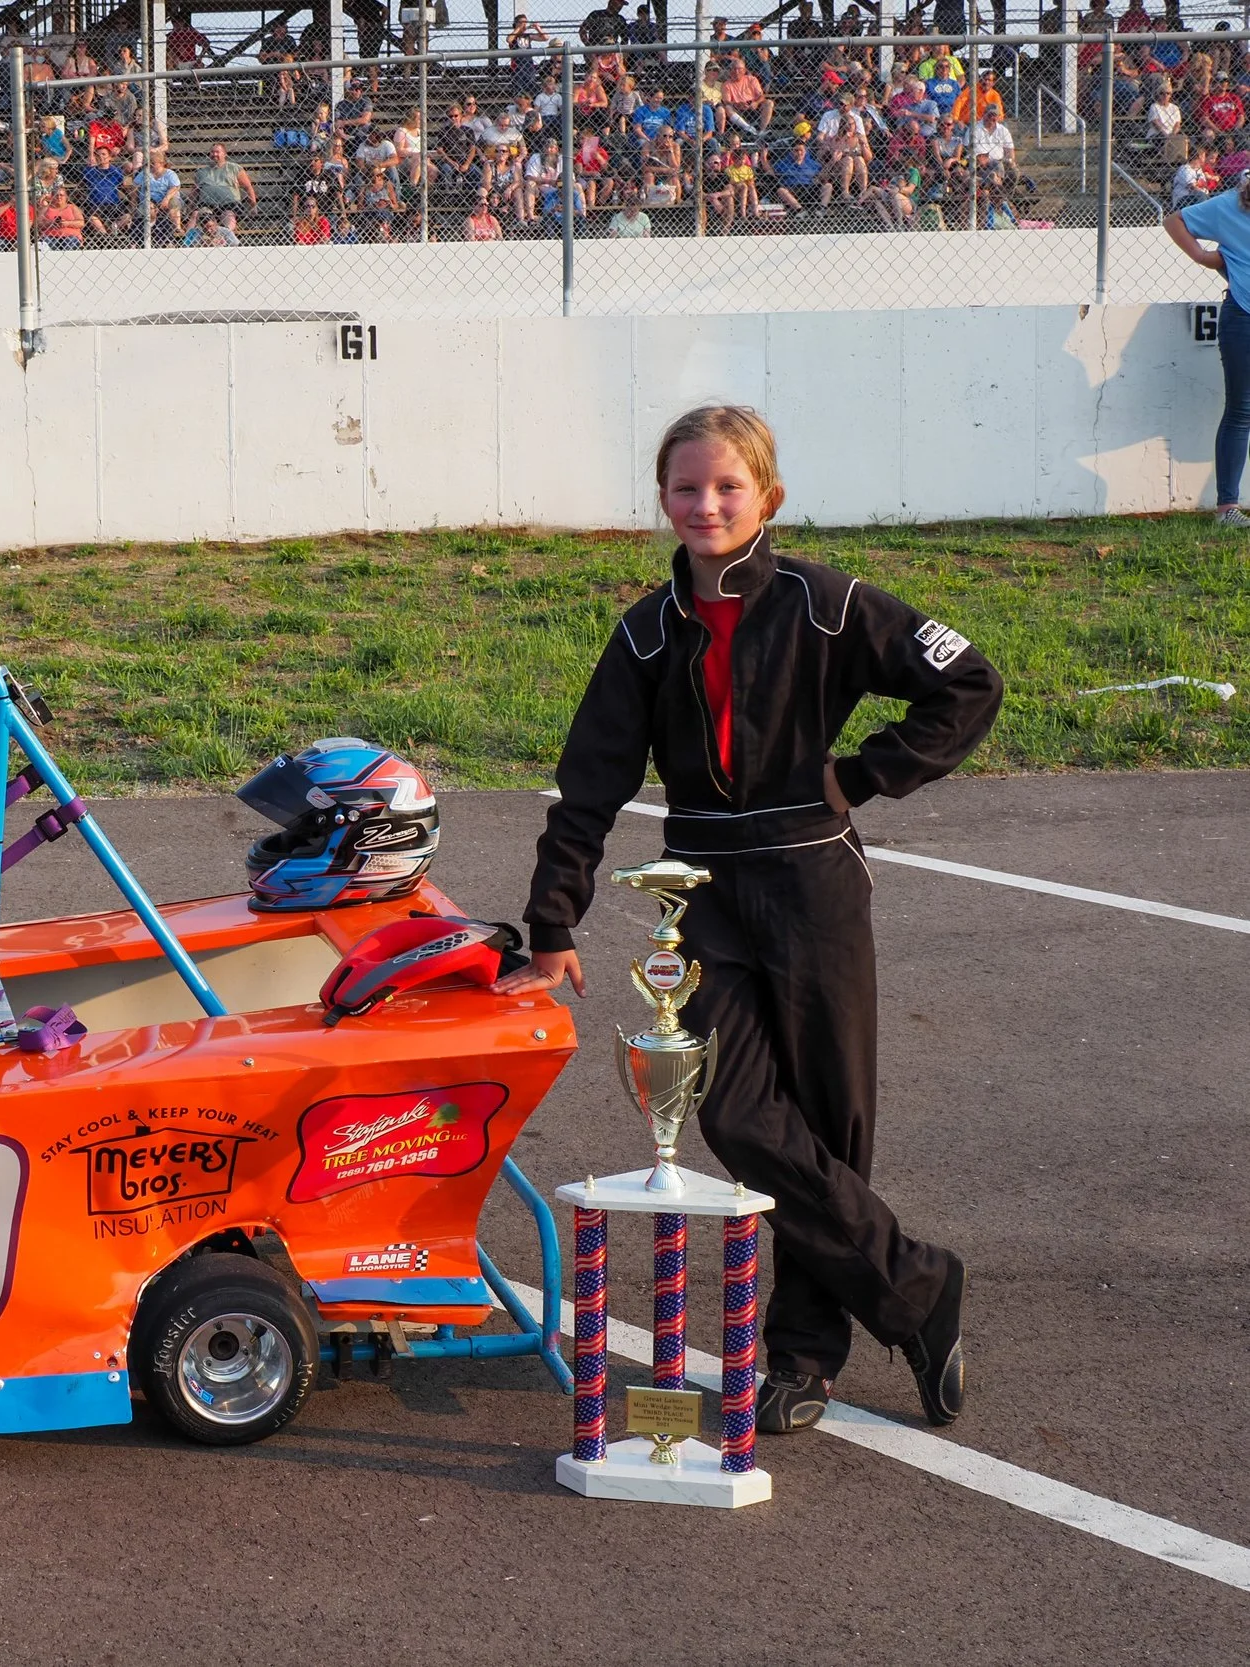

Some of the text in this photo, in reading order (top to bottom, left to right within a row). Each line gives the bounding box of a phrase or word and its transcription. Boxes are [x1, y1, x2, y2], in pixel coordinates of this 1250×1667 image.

[918, 622, 938, 641] CROW
[40, 1107, 279, 1163] STAY COOL & KEEP YOUR HEAT
[322, 1129, 468, 1170] TREE MOVING LLC
[336, 1147, 439, 1180] (269) 760-1356
[93, 1198, 228, 1240] INSUATION
[348, 1263, 410, 1272] AUTOMOTIVE
[350, 1252, 411, 1267] LANE
[633, 1401, 648, 1409] Mini
[650, 1402, 671, 1411] Wedge
